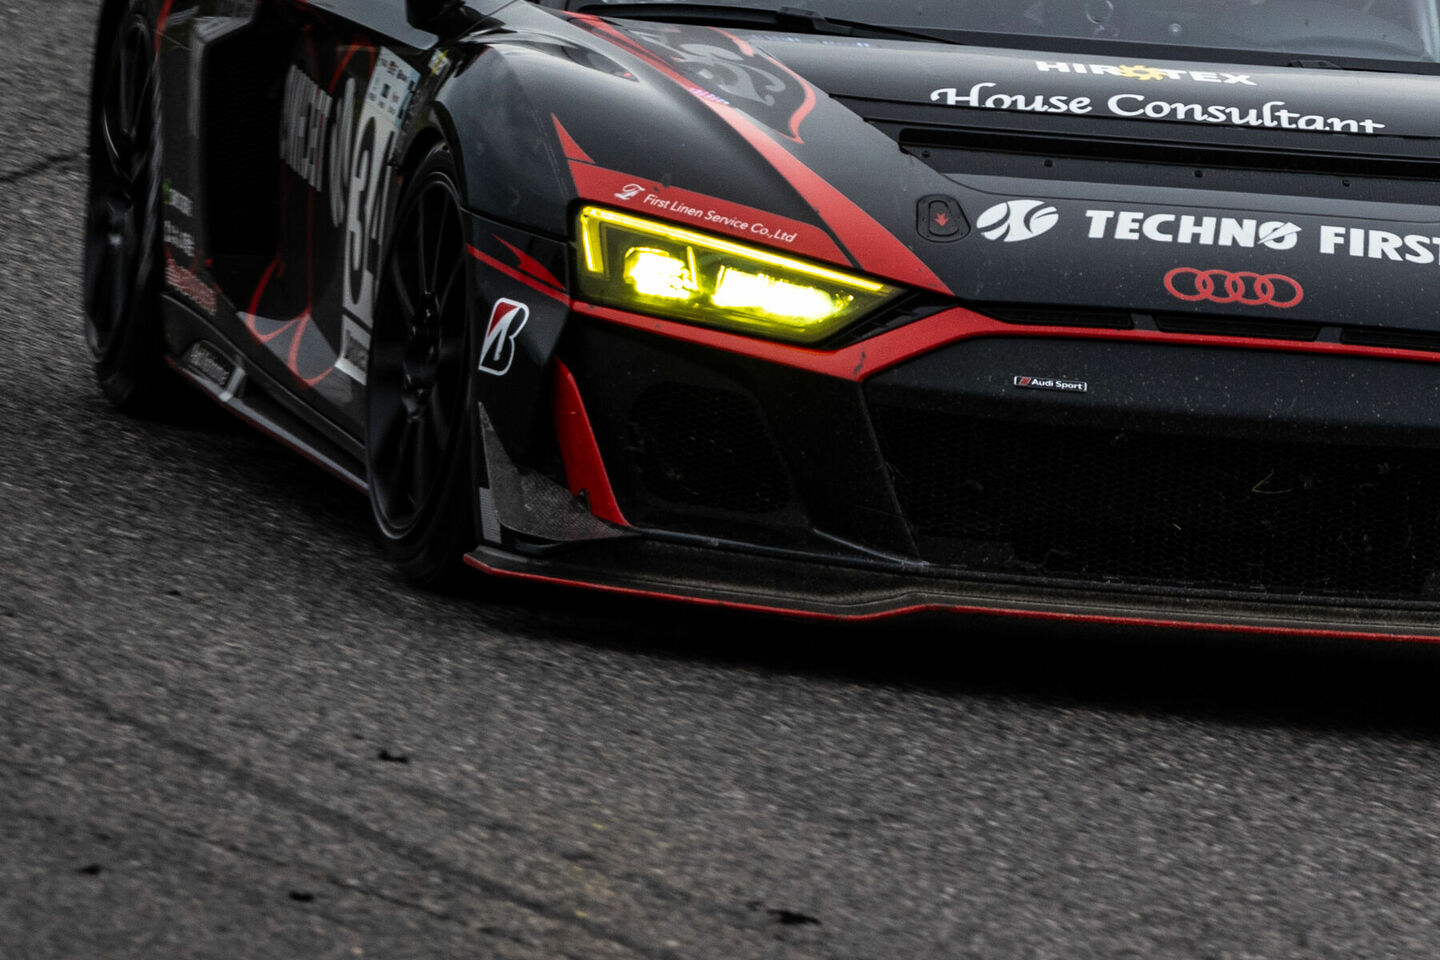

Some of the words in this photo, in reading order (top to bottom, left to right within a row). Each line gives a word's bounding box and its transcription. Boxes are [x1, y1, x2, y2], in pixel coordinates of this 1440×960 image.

[929, 82, 1092, 115] House
[1107, 93, 1386, 134] Consultant
[643, 193, 671, 210] First
[671, 202, 703, 219] Linen
[704, 210, 749, 231] Service
[1085, 209, 1302, 251] TECHNO
[1032, 378, 1054, 387] Audi
[1055, 380, 1084, 390] Sport
